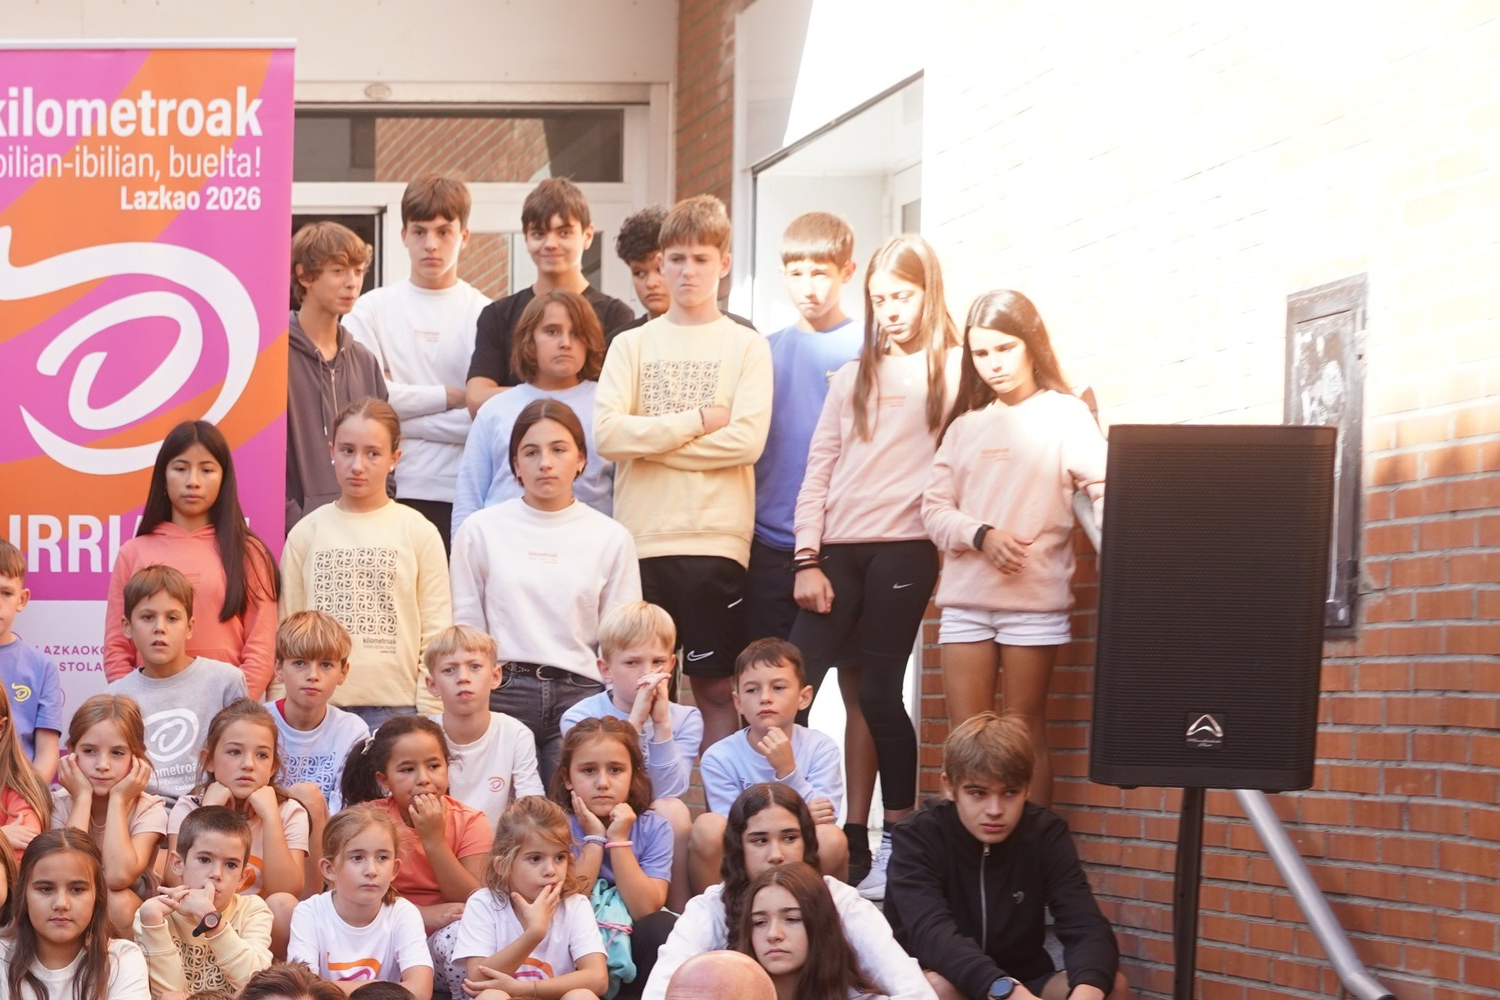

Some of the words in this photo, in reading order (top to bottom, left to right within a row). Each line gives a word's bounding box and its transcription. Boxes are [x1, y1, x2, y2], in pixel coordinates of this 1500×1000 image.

[169, 145, 261, 178] buelta!
[121, 185, 201, 210] Lazkao
[206, 186, 261, 210] 2026
[8, 514, 146, 573] IRRI
